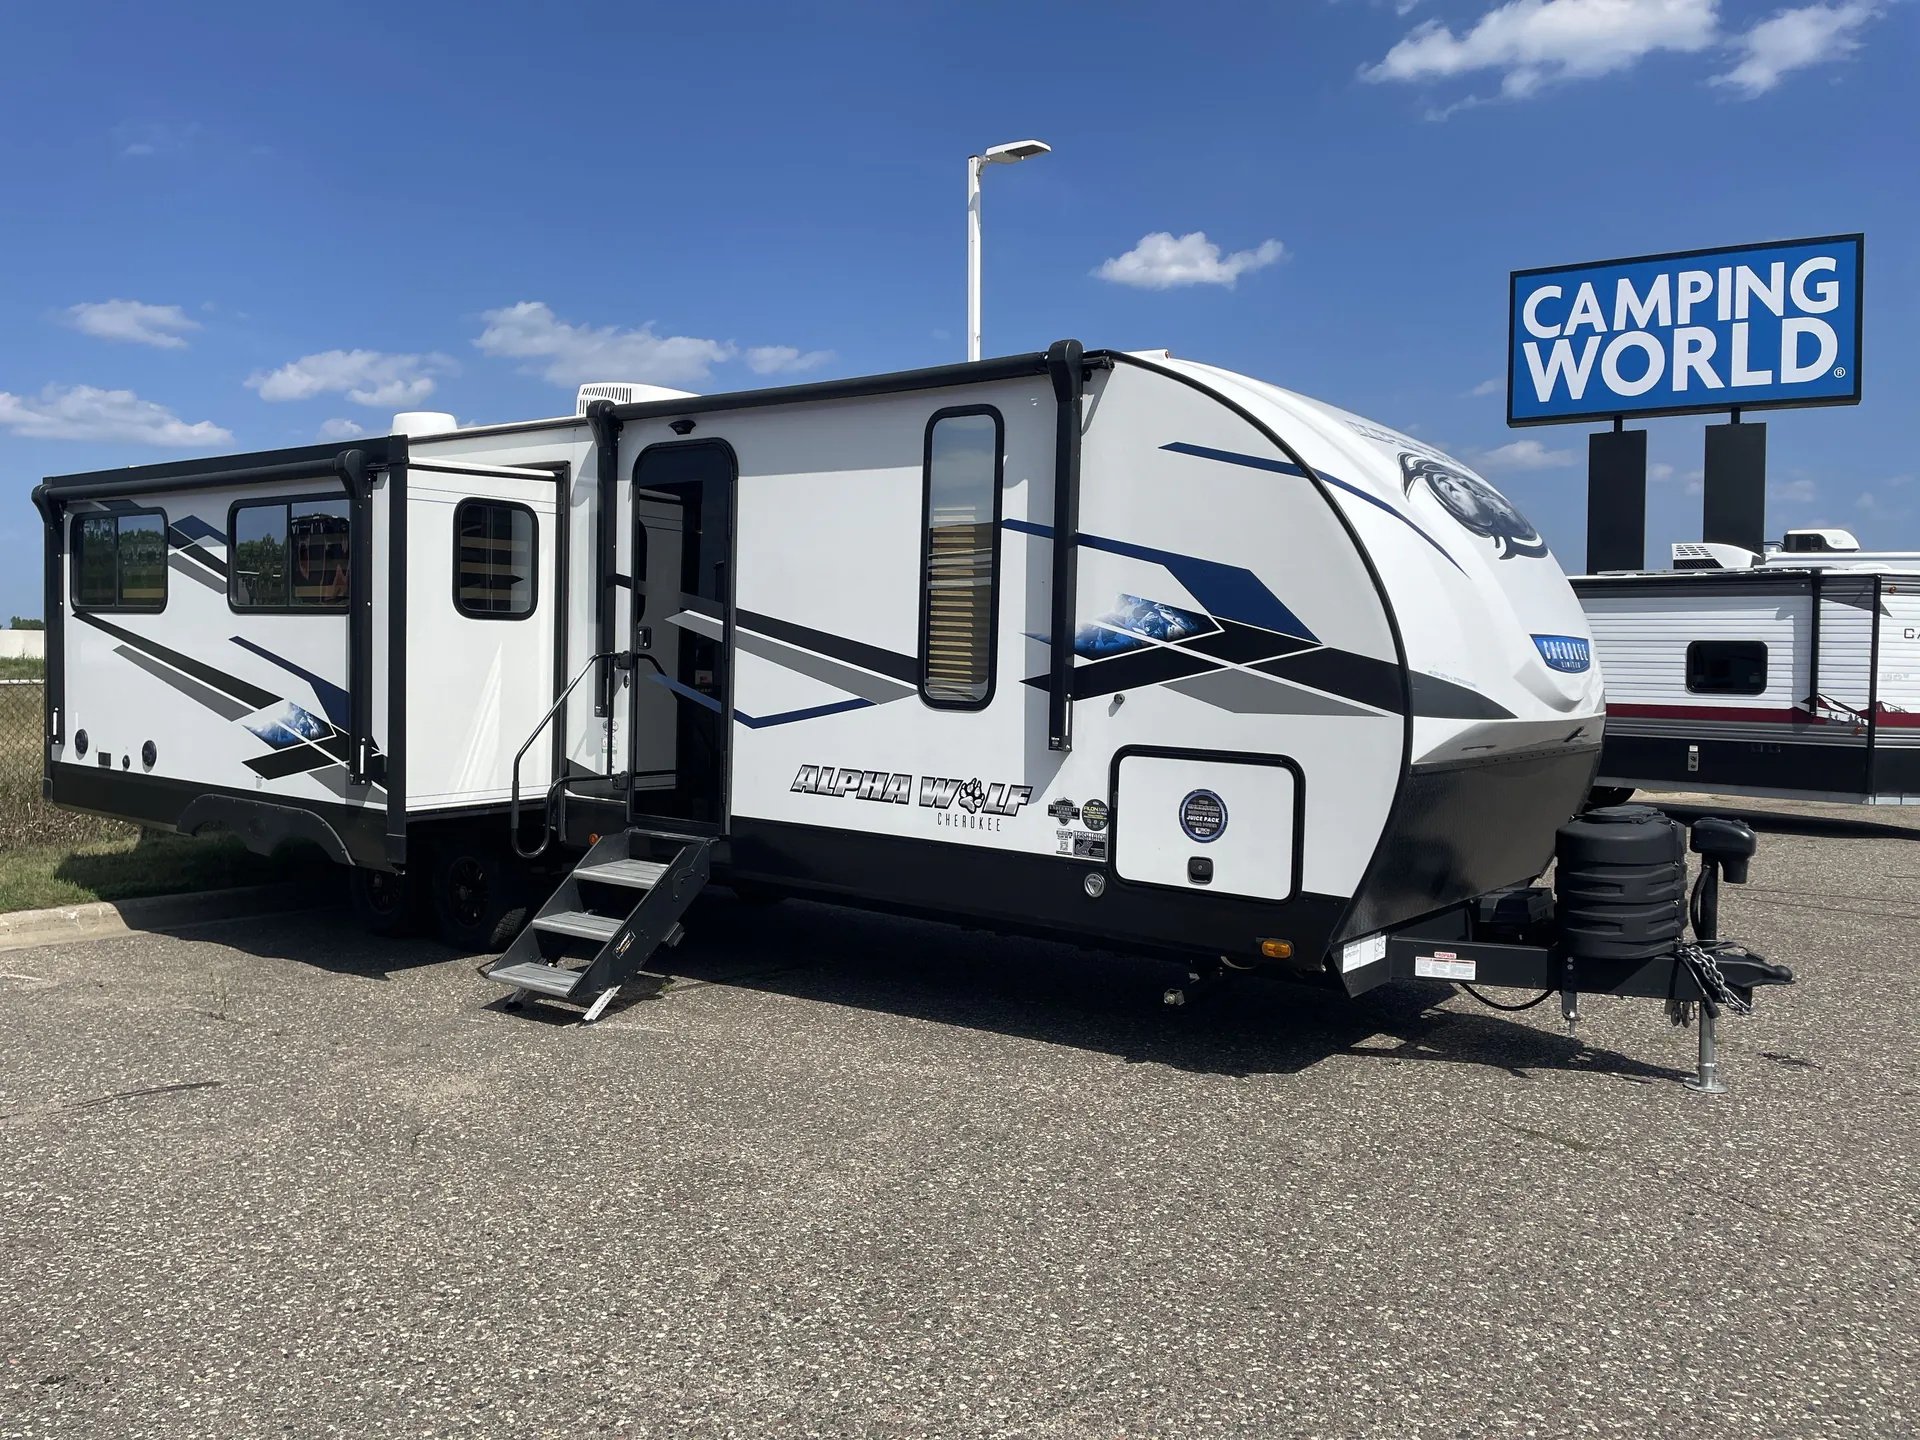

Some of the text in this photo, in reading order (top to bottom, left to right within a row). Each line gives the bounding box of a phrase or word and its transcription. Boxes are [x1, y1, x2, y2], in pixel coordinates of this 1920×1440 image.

[1522, 256, 1839, 339] CAMPING
[790, 764, 912, 805] ALPHA
[937, 812, 1001, 832] CHEROKEE
